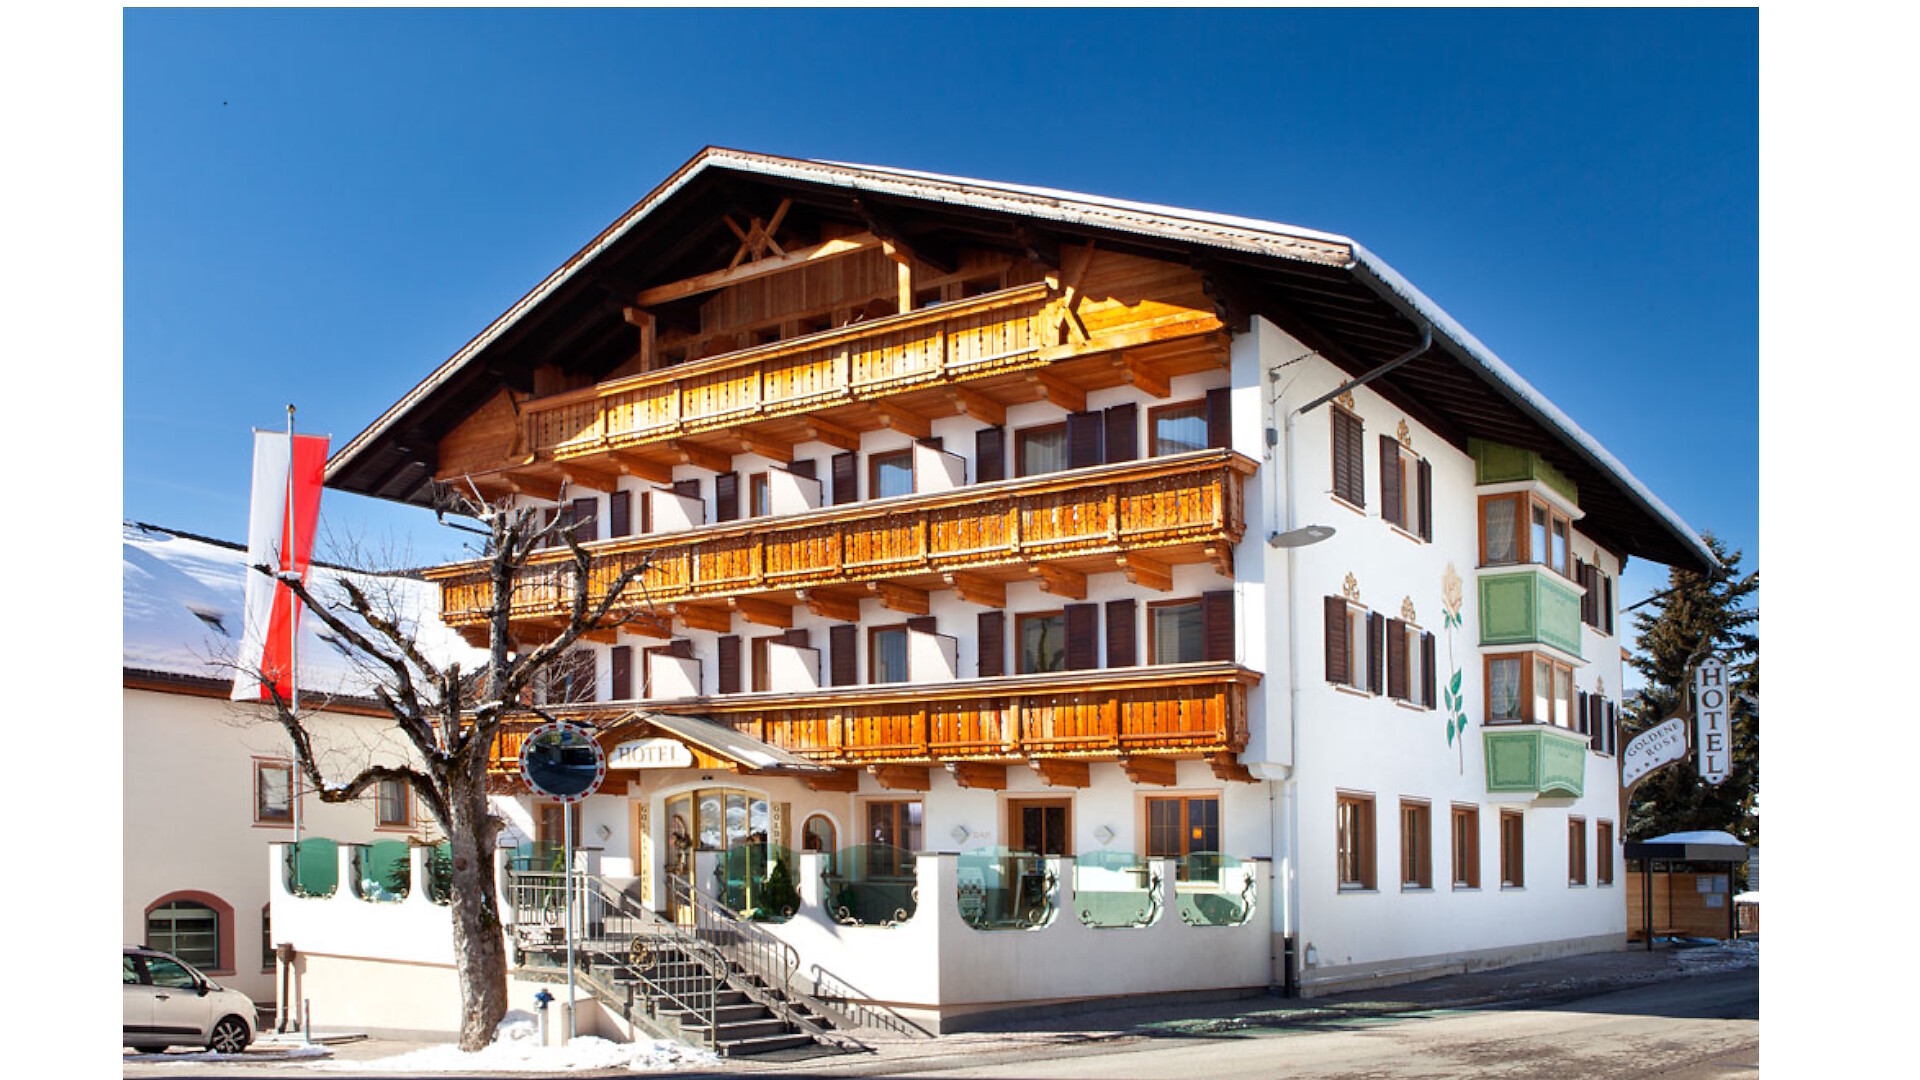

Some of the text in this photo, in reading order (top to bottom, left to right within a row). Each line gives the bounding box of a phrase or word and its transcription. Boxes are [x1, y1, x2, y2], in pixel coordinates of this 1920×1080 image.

[1701, 668, 1723, 773] HOTEL
[1627, 722, 1678, 757] GOLDENE
[1645, 735, 1679, 757] ROSE
[617, 745, 678, 763] HOTEL
